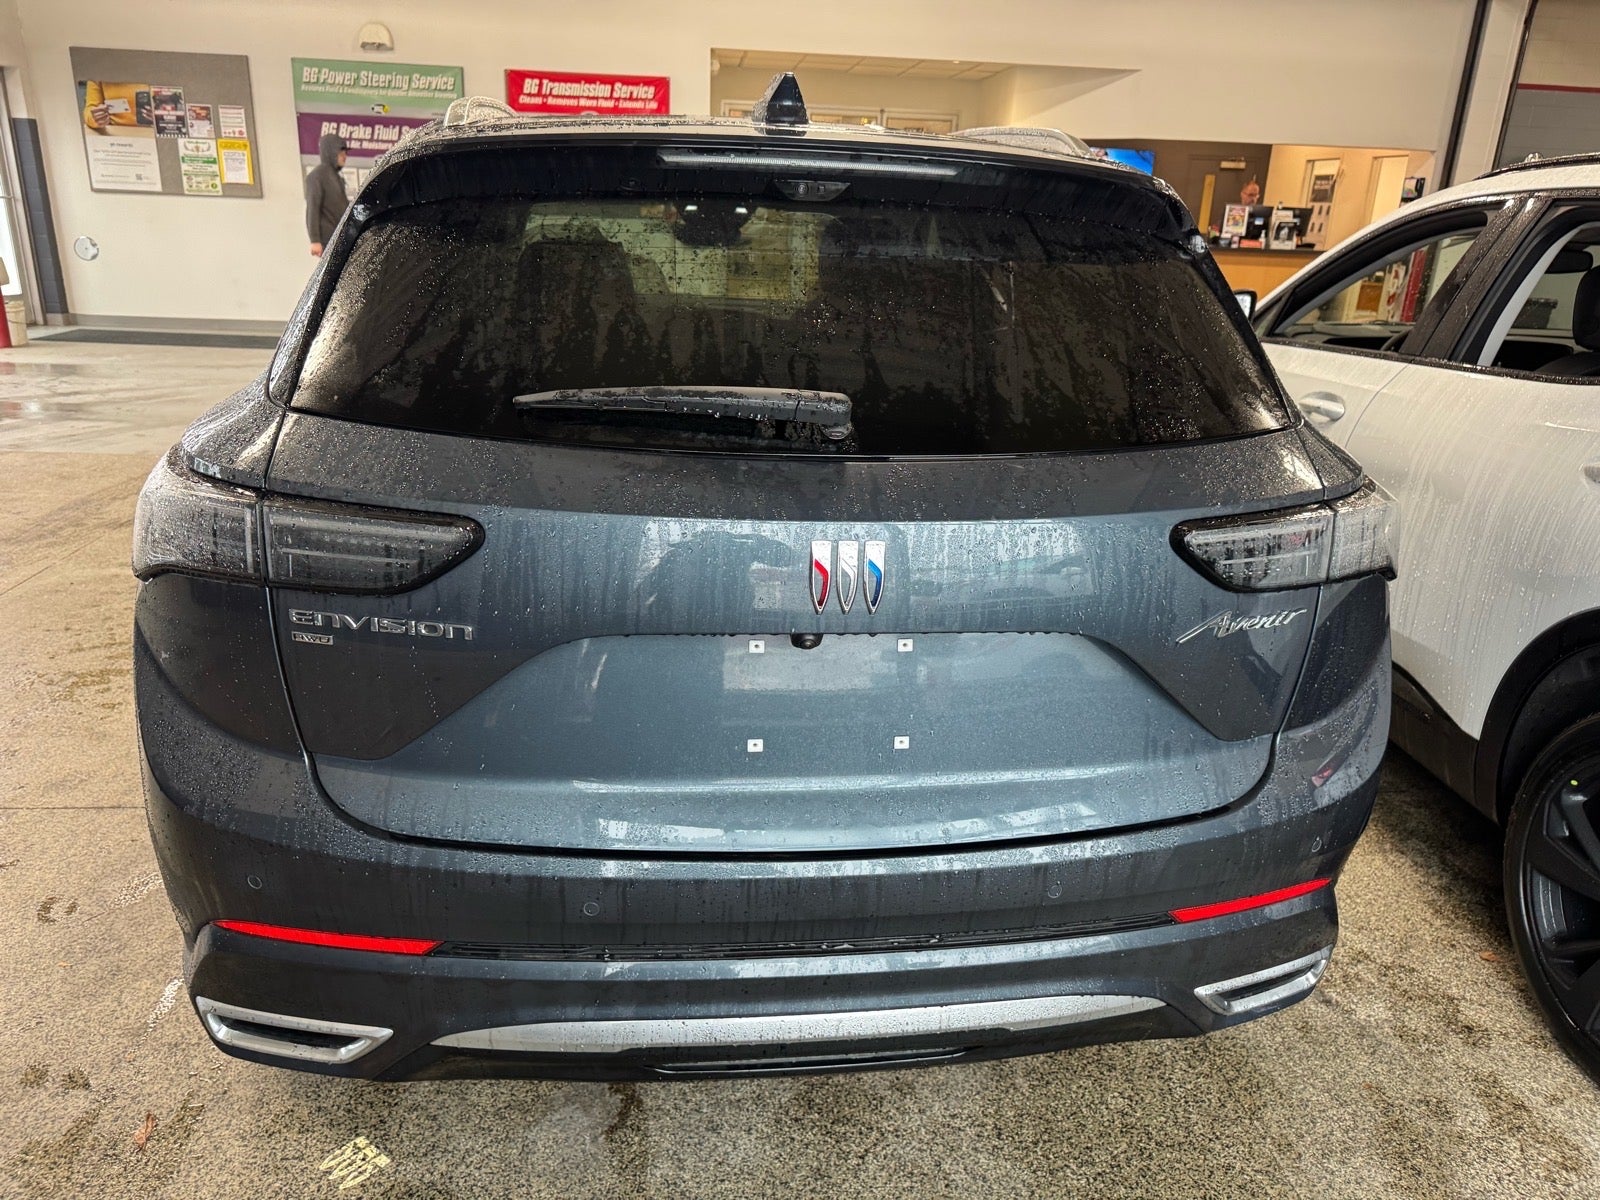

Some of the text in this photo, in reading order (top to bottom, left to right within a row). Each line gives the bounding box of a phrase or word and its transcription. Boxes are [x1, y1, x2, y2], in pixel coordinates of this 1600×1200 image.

[302, 66, 455, 91] BG Power Steering Service
[523, 78, 656, 99] BG Transmission Service
[519, 95, 542, 104] Cleans
[546, 96, 578, 106] Removes
[598, 98, 615, 108] Fluid
[645, 100, 658, 109] Life
[321, 121, 338, 136] BG
[338, 122, 372, 139] Brake
[374, 124, 399, 141] Fluid
[289, 608, 474, 641] ENVISION
[1175, 608, 1308, 644] Avenir
[292, 632, 332, 645] AWD
